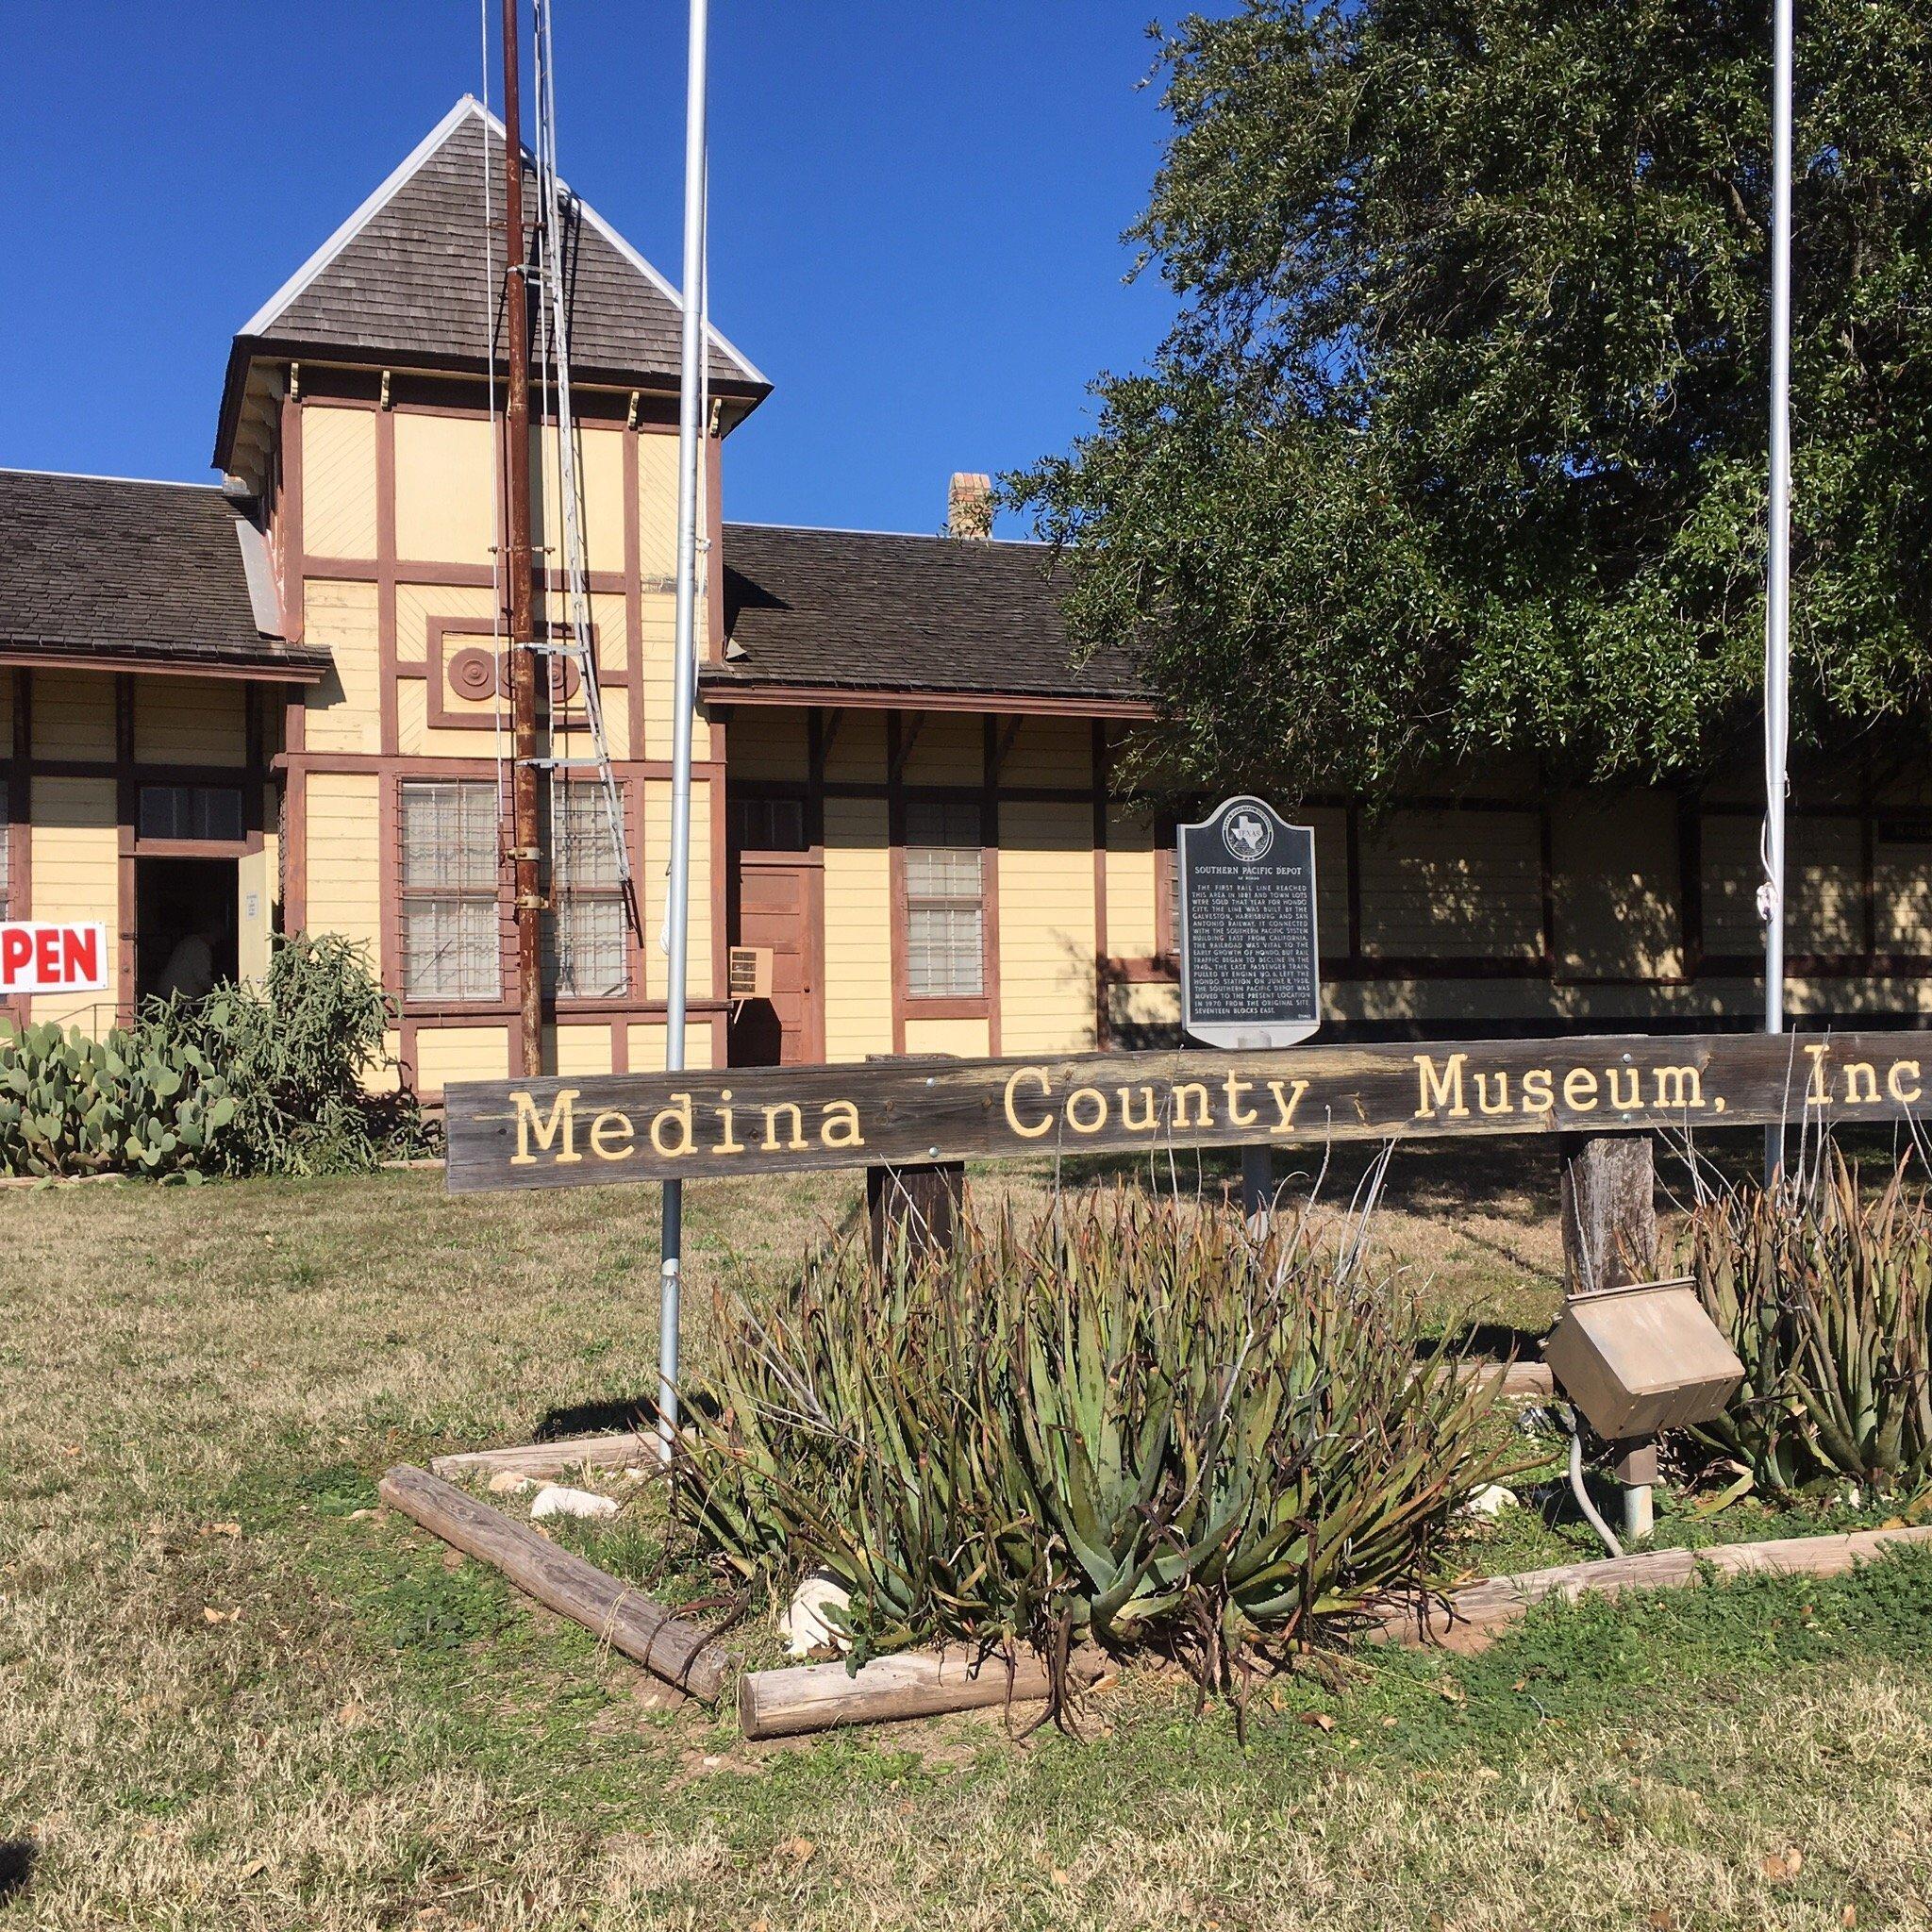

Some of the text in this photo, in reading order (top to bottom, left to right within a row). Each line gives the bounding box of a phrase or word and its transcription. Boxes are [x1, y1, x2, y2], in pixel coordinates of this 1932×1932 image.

[1194, 866, 1303, 874] SOUTHERN PACIFIC DEPOT
[0, 928, 97, 985] PEN
[508, 1044, 1923, 1165] Medina County Museum, Inc
